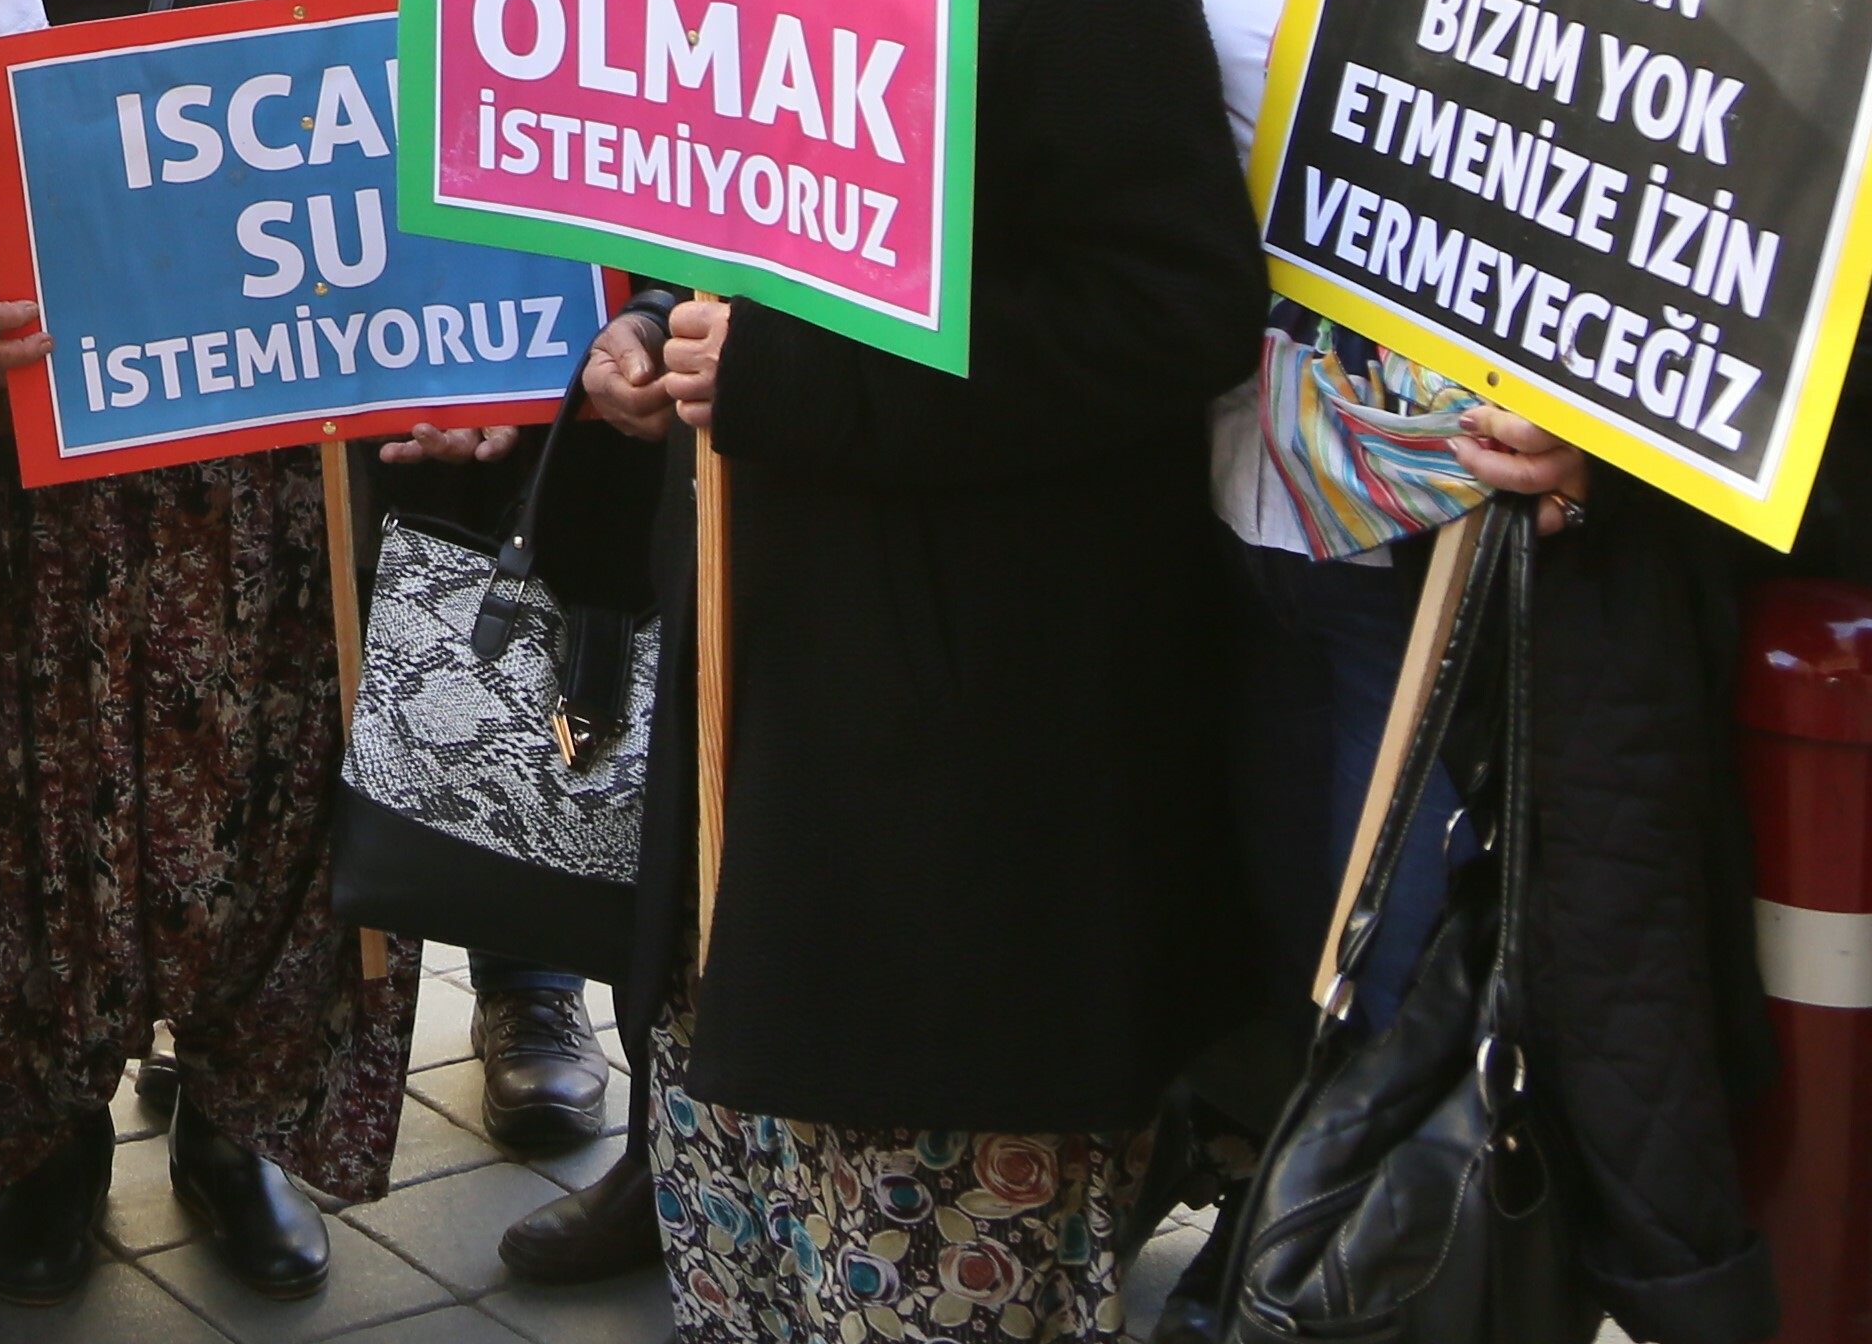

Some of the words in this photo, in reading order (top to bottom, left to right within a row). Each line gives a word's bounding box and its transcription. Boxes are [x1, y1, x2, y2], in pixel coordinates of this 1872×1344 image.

[116, 59, 398, 189] ISCA
[1597, 34, 1744, 166] YOK
[235, 188, 388, 298] SU
[478, 89, 899, 267] İSTEMİYORUZ
[1331, 61, 1628, 254] ETMENİZE
[1628, 163, 1780, 319] İZİN
[81, 296, 568, 411] İSTEMİYORUZ
[1304, 165, 1762, 451] VERMEYECEĞİZ
